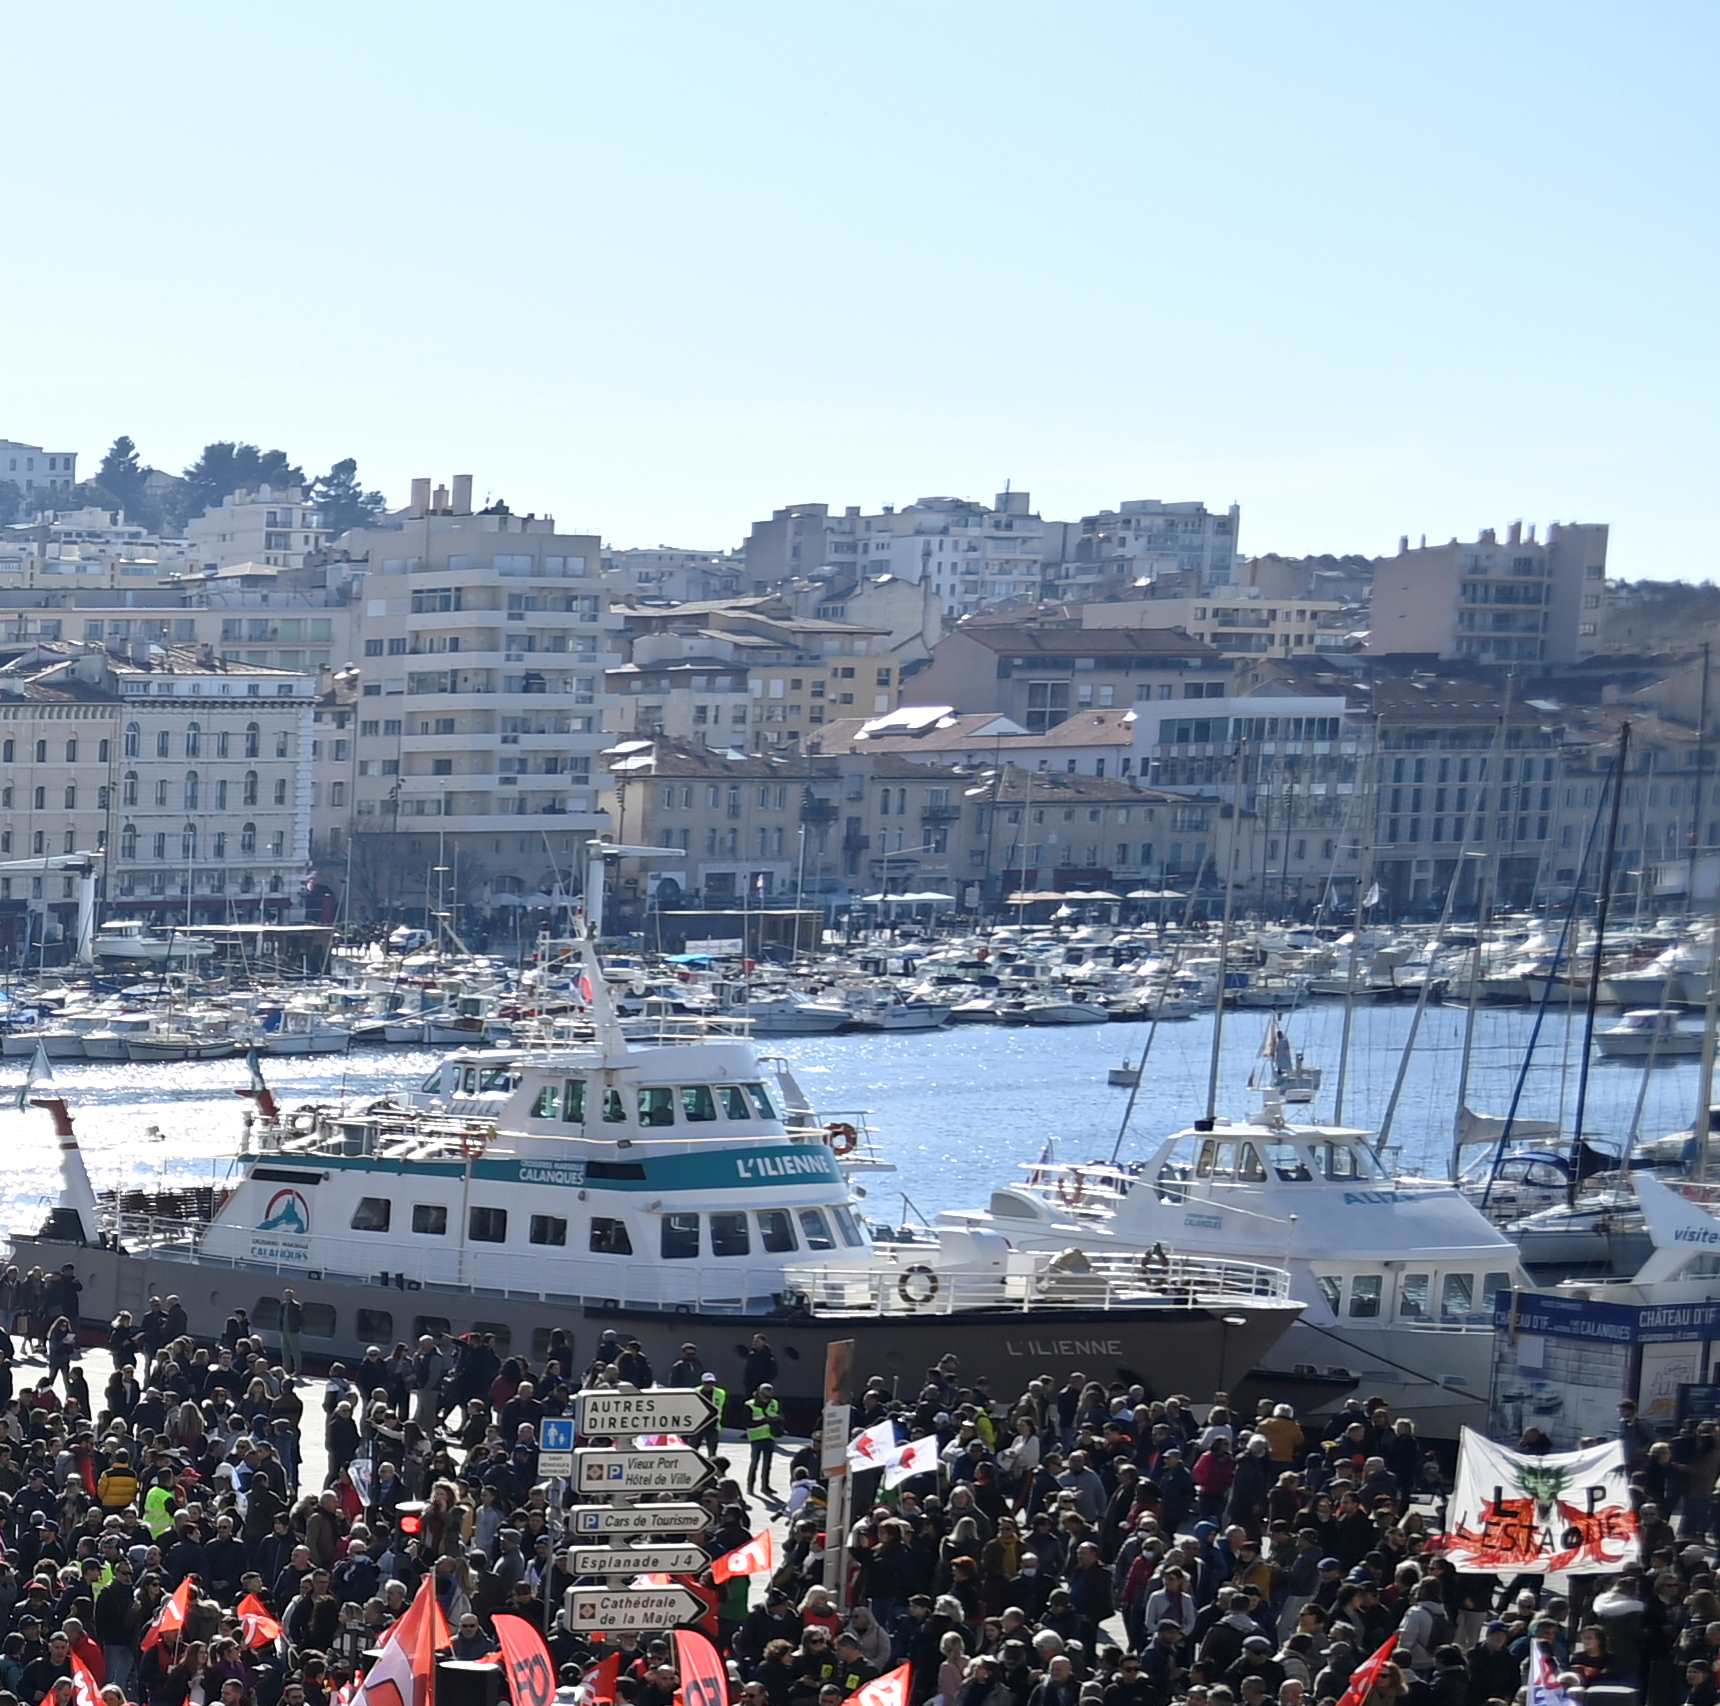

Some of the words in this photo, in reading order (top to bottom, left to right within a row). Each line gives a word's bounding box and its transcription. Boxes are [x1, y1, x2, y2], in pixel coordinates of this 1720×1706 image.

[737, 1155, 830, 1179] L'ILIENNE
[1006, 1339, 1123, 1358] L'ILIENNE
[589, 1399, 655, 1414] AUTRES
[588, 1414, 693, 1430] DIRECTIONS
[627, 1457, 654, 1472] Vieux
[658, 1457, 680, 1471] Port
[625, 1470, 648, 1487] Hôtel
[650, 1472, 662, 1486] de
[667, 1469, 692, 1486] Ville
[605, 1513, 630, 1529] Cars
[633, 1513, 646, 1527] de
[649, 1512, 700, 1528] Tourisme
[580, 1552, 660, 1572] Esplanade
[671, 1553, 681, 1568] J
[683, 1552, 693, 1568] 4
[599, 1594, 676, 1611] Cathédrale
[599, 1611, 613, 1626] de
[622, 1610, 635, 1624] la
[642, 1609, 683, 1627] Major
